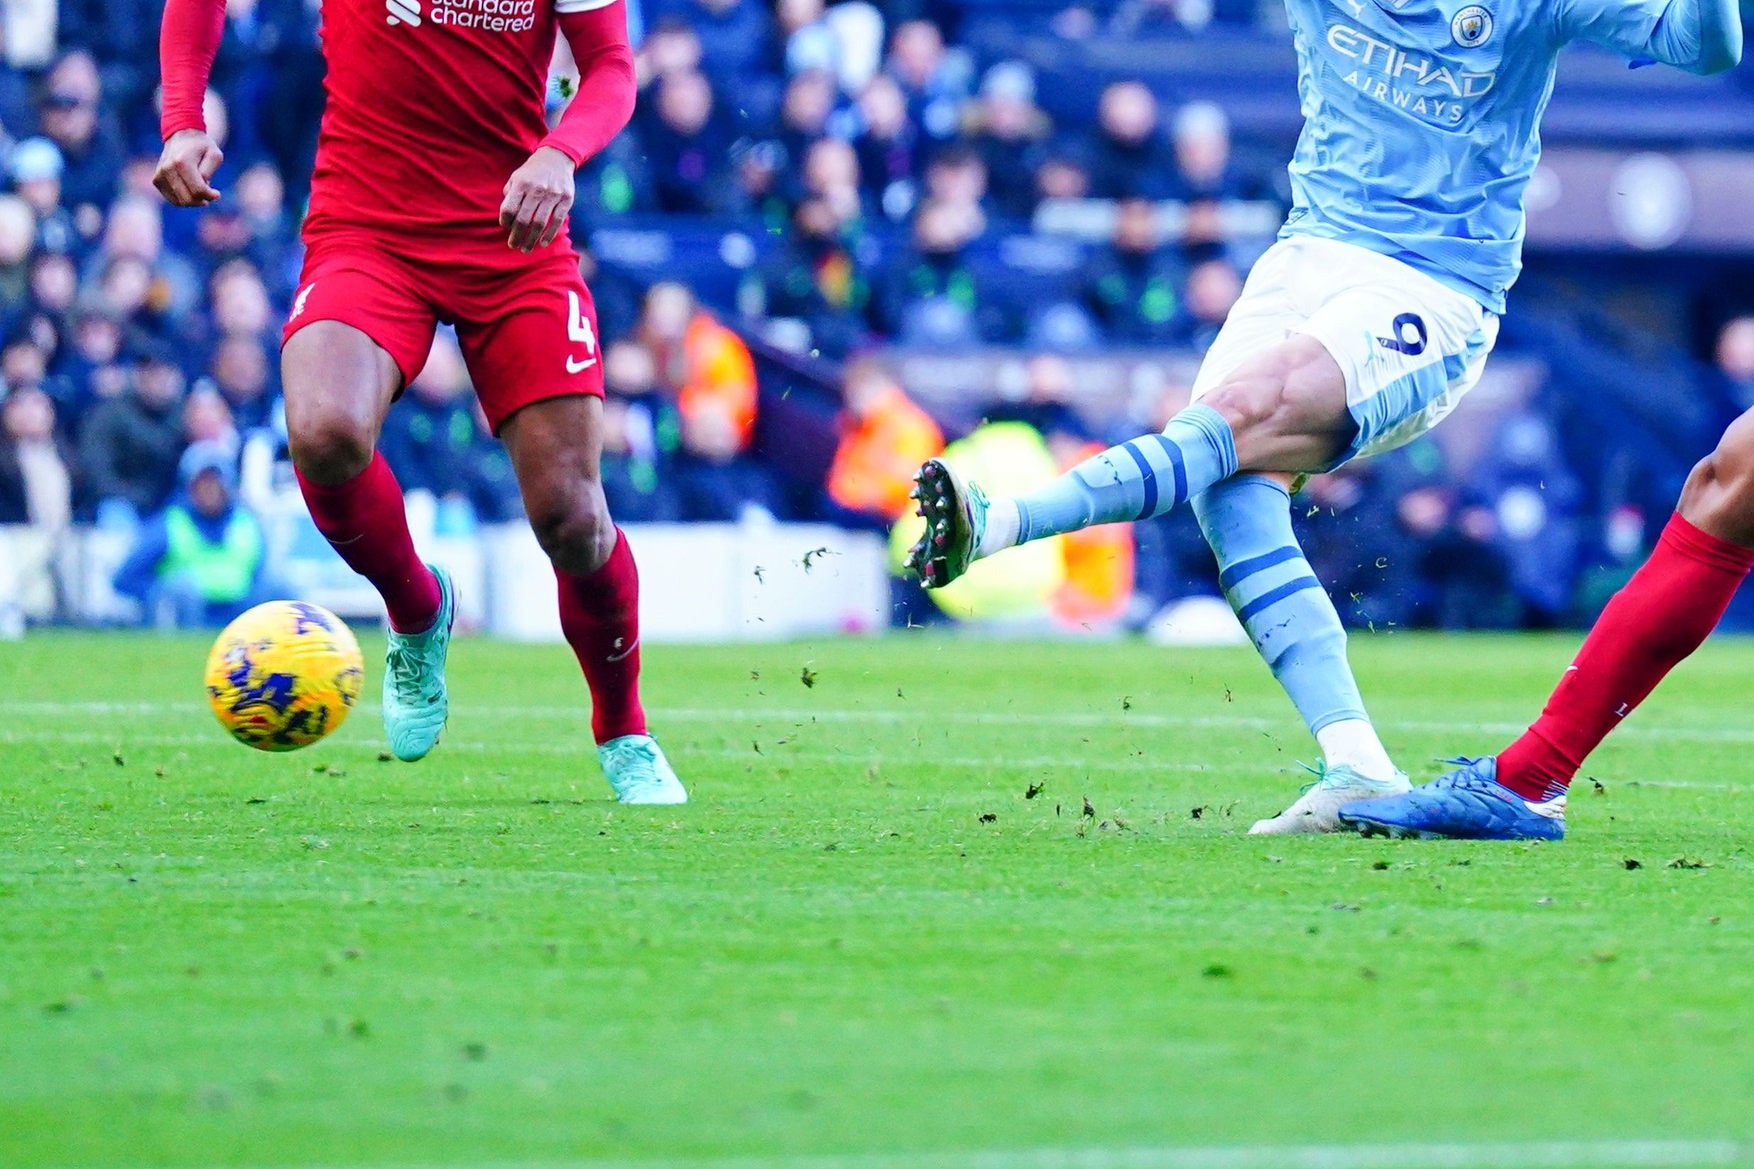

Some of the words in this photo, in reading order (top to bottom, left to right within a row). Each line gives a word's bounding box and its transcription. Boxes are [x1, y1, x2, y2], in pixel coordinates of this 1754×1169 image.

[430, 7, 536, 33] chartered
[1327, 24, 1496, 98] ETIHAD
[1343, 70, 1463, 123] AIRWAYS
[567, 289, 596, 354] 4
[1376, 312, 1428, 357] 9
